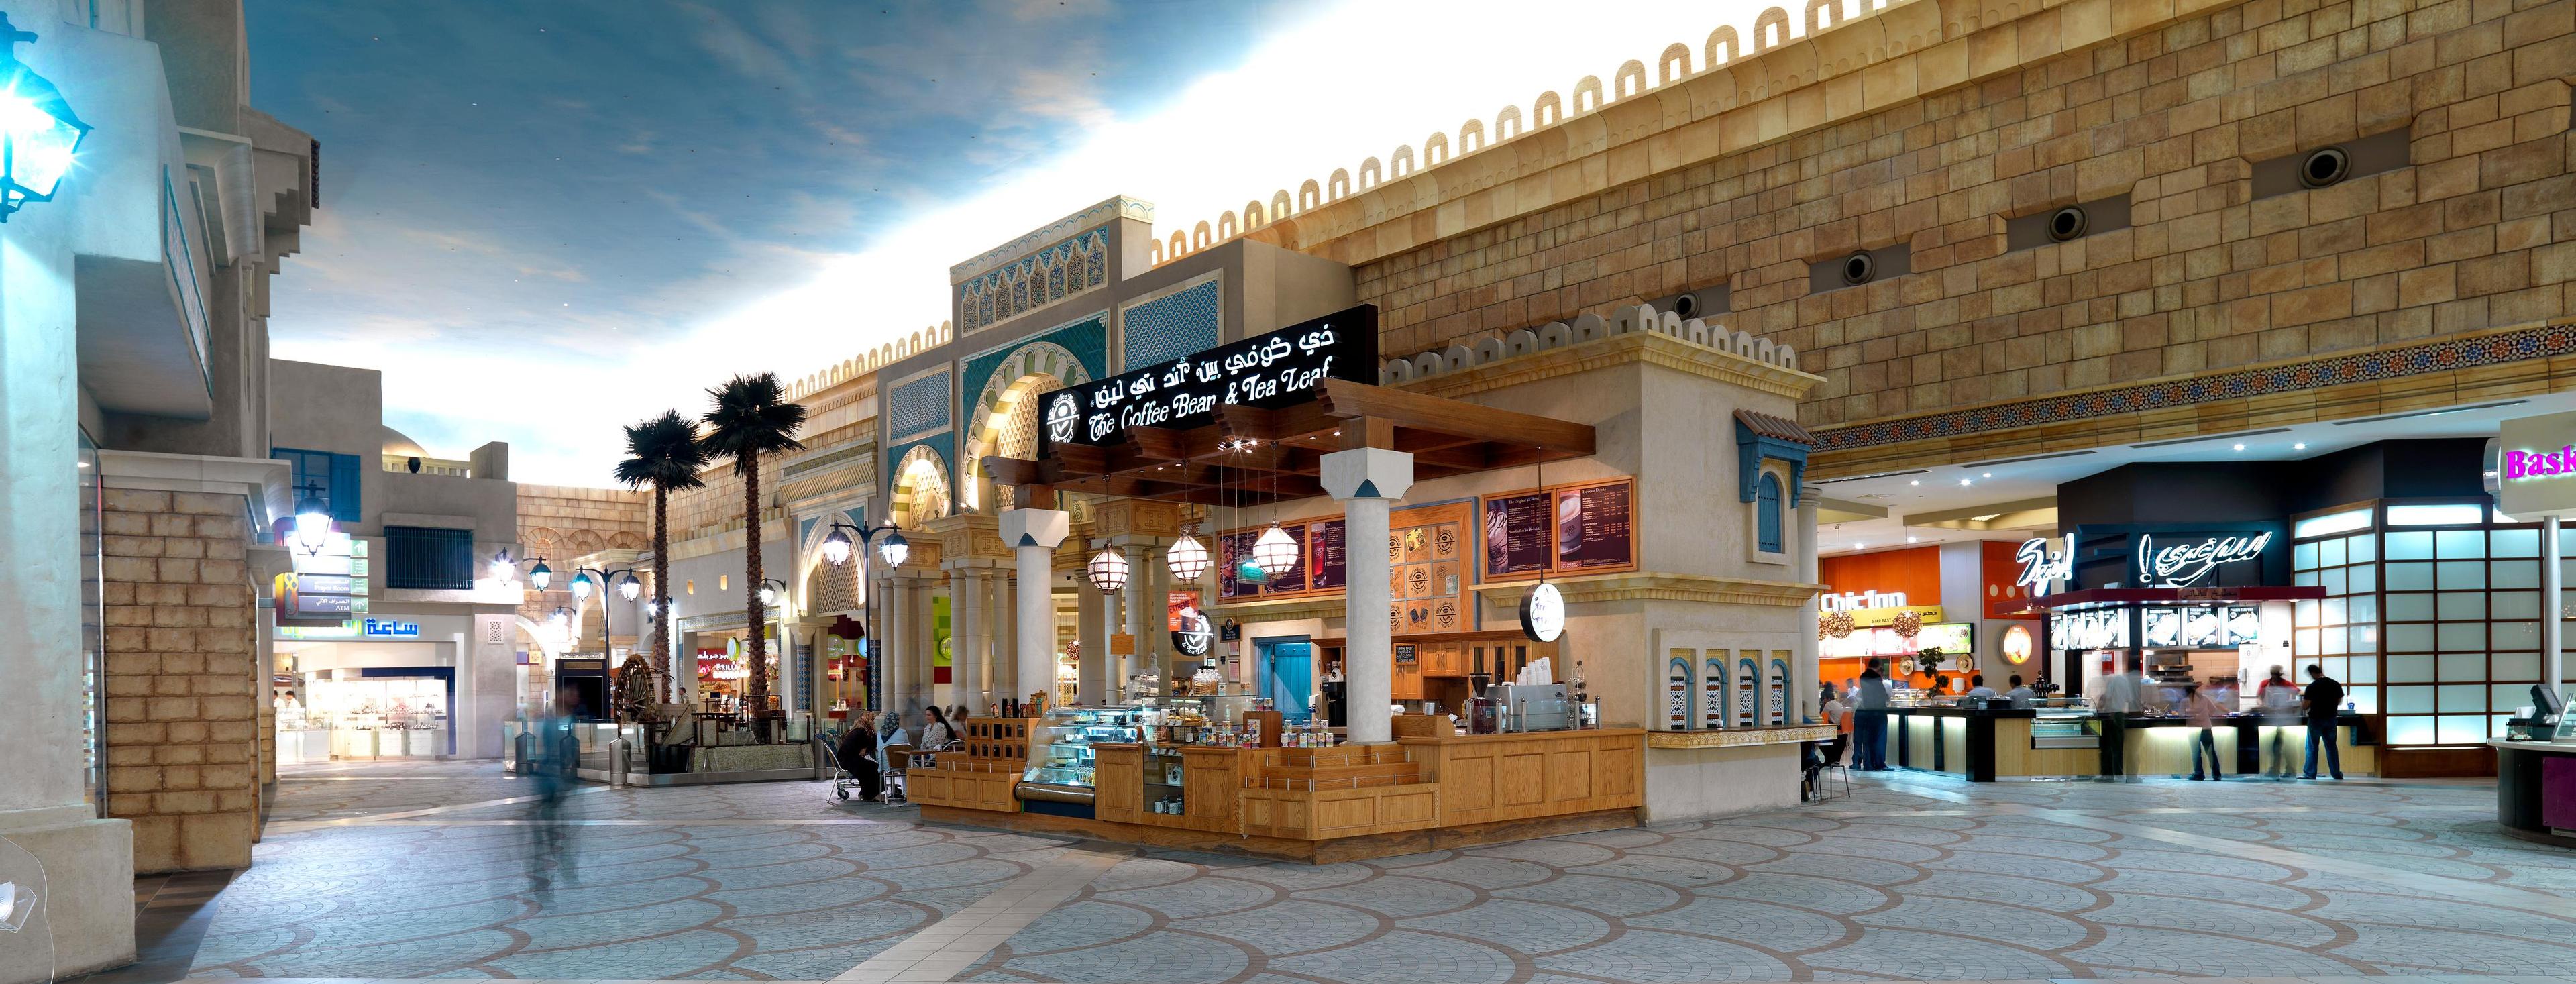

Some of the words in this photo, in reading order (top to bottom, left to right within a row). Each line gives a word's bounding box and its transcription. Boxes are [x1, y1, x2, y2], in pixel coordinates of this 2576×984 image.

[1299, 323, 1335, 356] ذي
[1224, 337, 1291, 374] كوفي
[1196, 360, 1222, 383] بين
[1089, 414, 1115, 441] The
[1121, 400, 1169, 429] Coffee
[1173, 393, 1216, 418] Bean
[1224, 382, 1238, 406] &
[1242, 374, 1277, 401] Tea
[1281, 356, 1334, 392] Leaf
[1094, 380, 1124, 409] ليف
[1130, 372, 1155, 401] تي
[2506, 445, 2576, 479] Bask
[1168, 600, 1191, 614] EXTREME
[366, 618, 418, 635] ساعة
